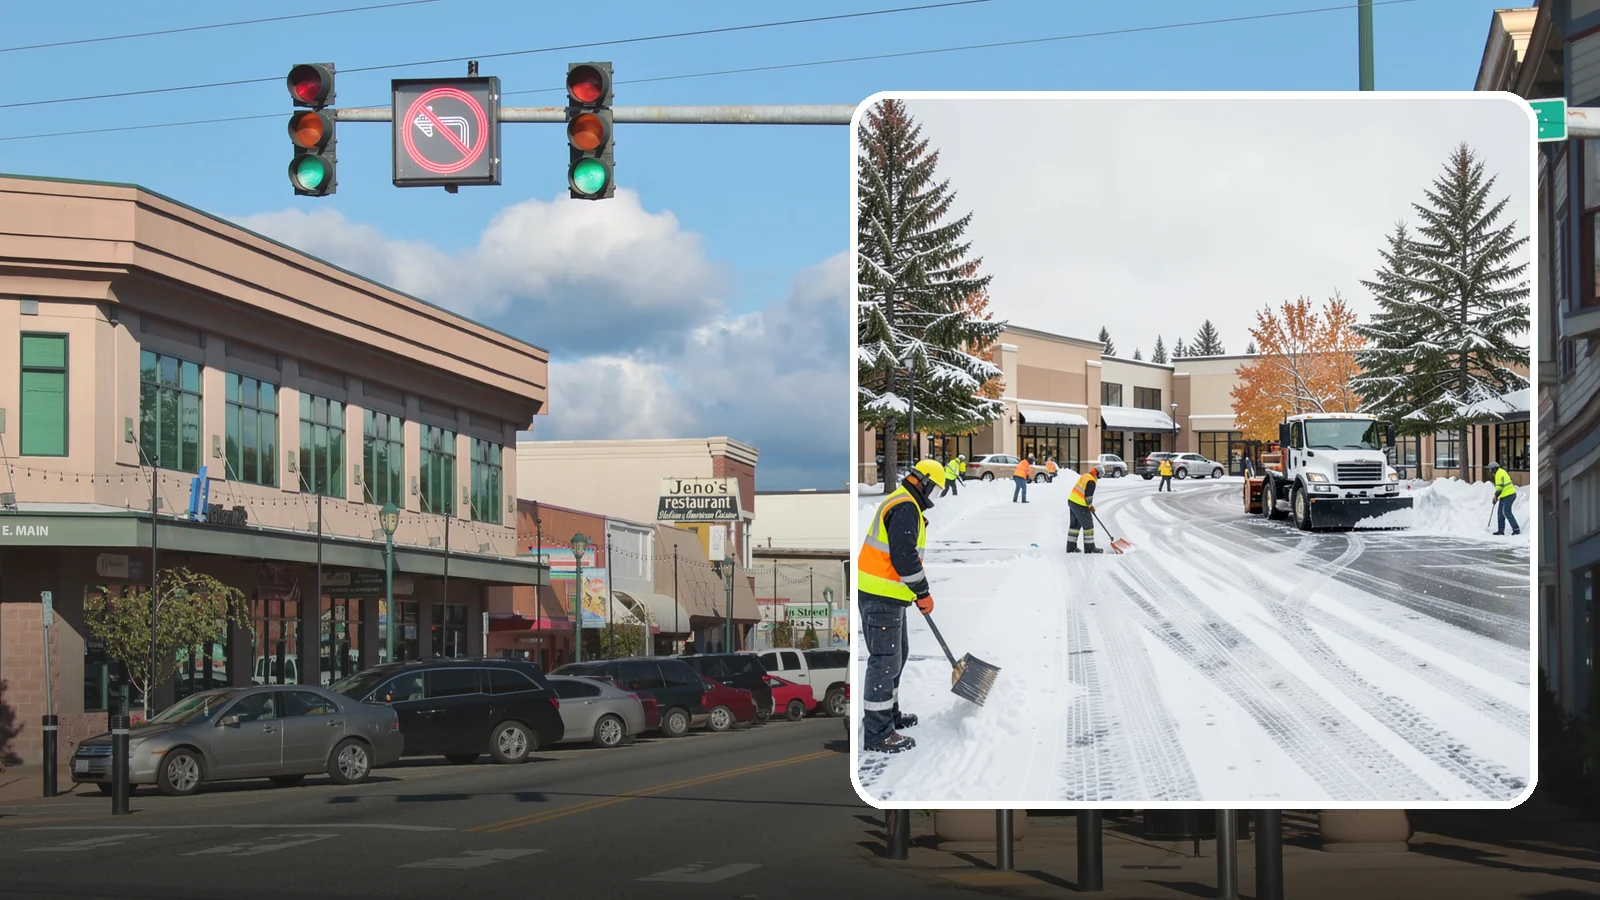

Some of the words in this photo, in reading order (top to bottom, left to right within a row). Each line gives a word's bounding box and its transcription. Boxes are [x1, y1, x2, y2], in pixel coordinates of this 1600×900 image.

[669, 480, 727, 494] Jeno's
[665, 497, 731, 509] restaurant
[2, 525, 13, 536] E.
[15, 525, 49, 536] MAIN
[797, 607, 828, 616] Street
